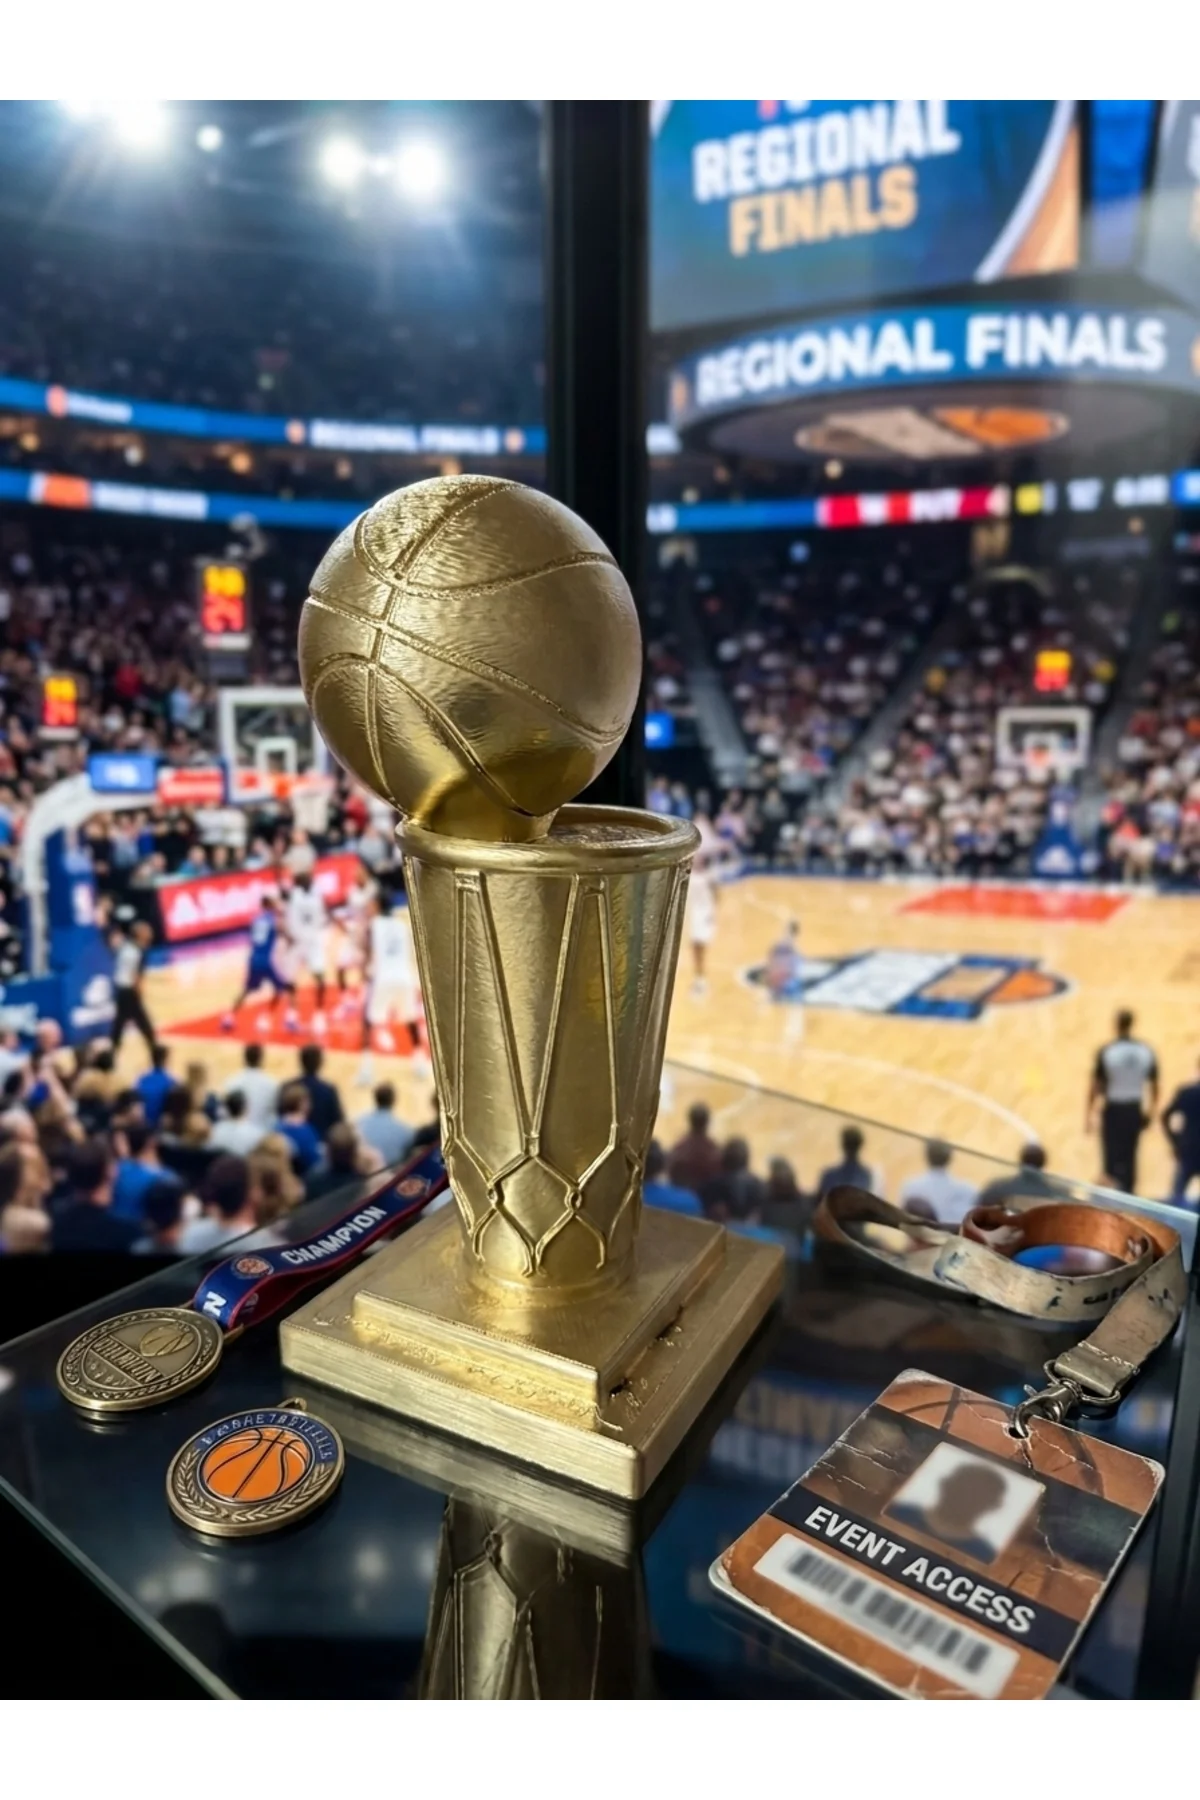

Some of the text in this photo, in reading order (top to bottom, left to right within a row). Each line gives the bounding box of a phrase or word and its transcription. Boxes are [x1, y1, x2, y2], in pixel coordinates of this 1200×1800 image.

[692, 100, 962, 204] REGIONAL
[729, 165, 918, 257] FINALS
[695, 313, 1167, 404] REGIONAL FINALS
[281, 1206, 388, 1265] CHAMPION
[804, 1505, 1037, 1635] EVENT ACCESS
